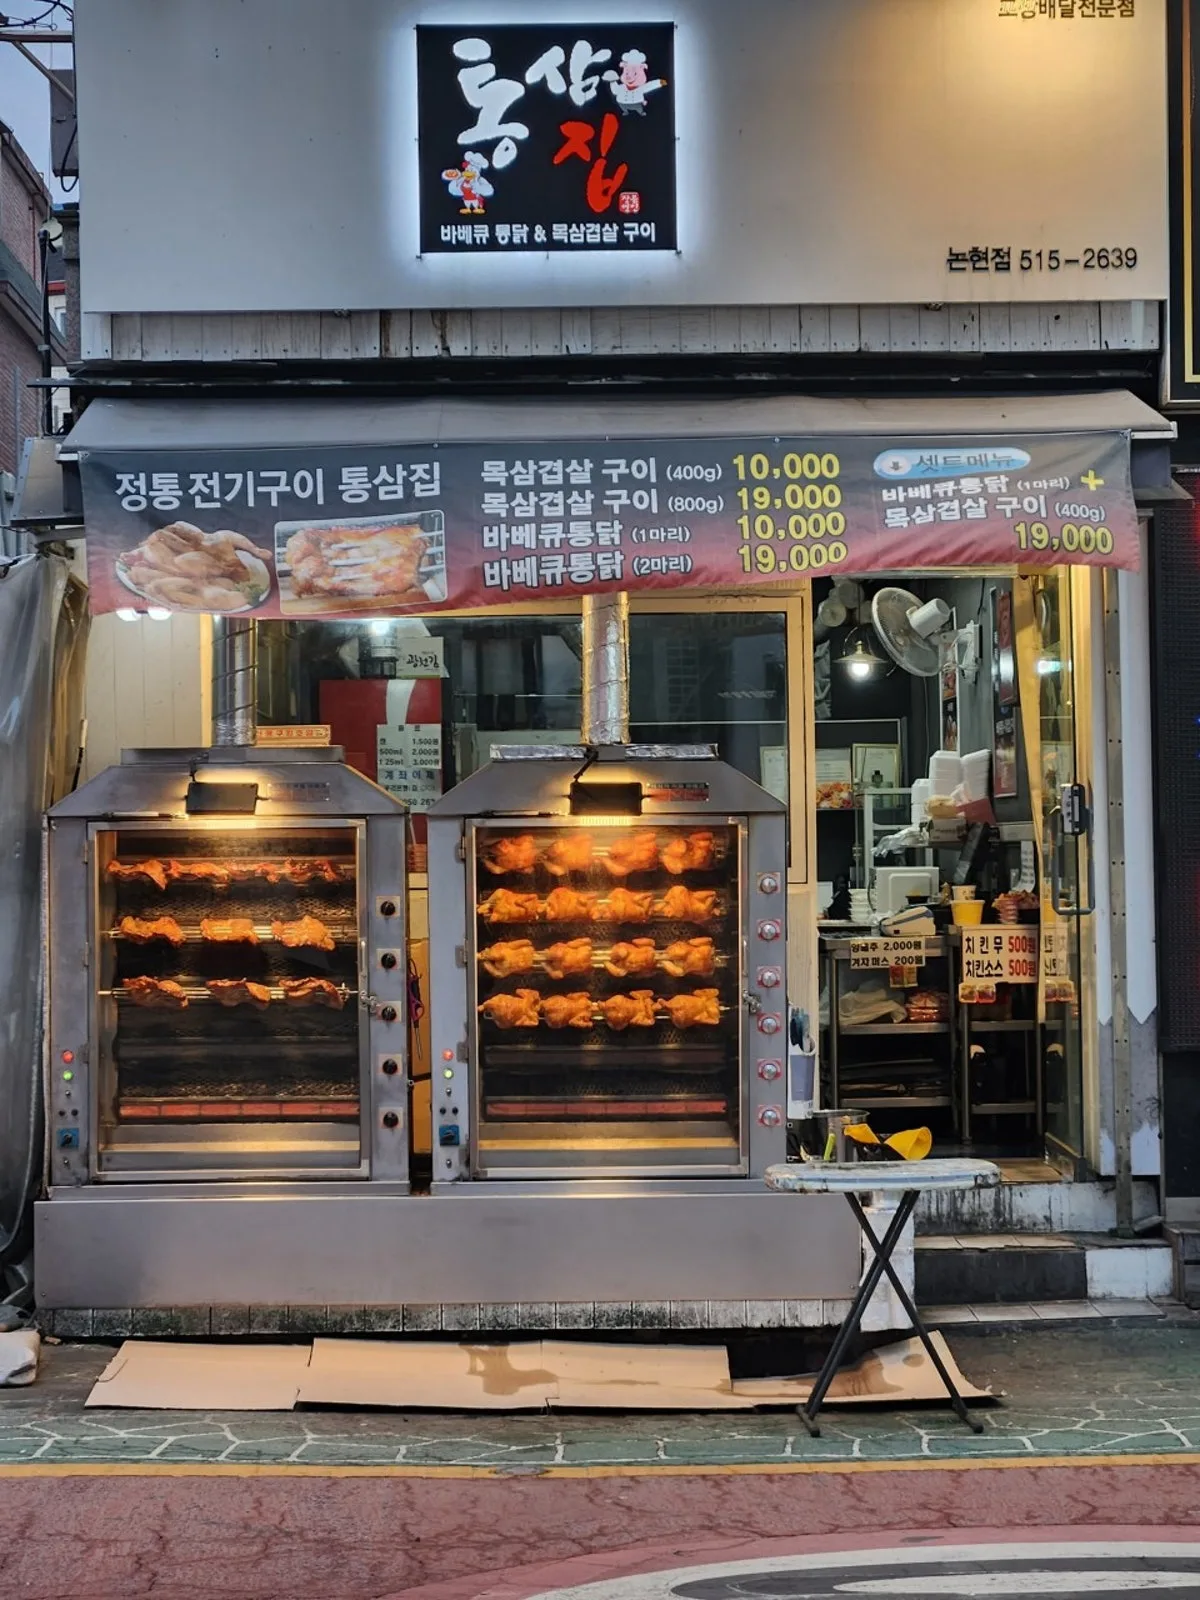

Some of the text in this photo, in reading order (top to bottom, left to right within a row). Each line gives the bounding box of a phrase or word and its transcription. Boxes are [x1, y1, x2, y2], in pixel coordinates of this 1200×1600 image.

[440, 221, 656, 245] 바베큐 통닭 & 목삼겹살 구이
[946, 247, 1137, 272] 논현점 515-2639
[187, 467, 324, 510] 전기구이
[338, 461, 442, 503] 통삼집
[480, 453, 841, 487] 목삼겹살 구이 (400g) 10,000
[480, 484, 842, 518] 목삼겹살 구이 (800g) 19,000
[881, 475, 1010, 503] 바베큐통닭
[1016, 475, 1071, 492] (1마리)
[884, 494, 1106, 529] 목삼겹살 구이 (400g)
[482, 512, 846, 552] 바베큐통닭 (1마리) 10,000
[1014, 521, 1113, 554] 19,000
[483, 541, 848, 592] 바베큐통닭 (2마리) 19,000
[1008, 935, 1037, 954] 500원
[965, 959, 1004, 978] 치킨소스
[1008, 959, 1037, 977] 500원
